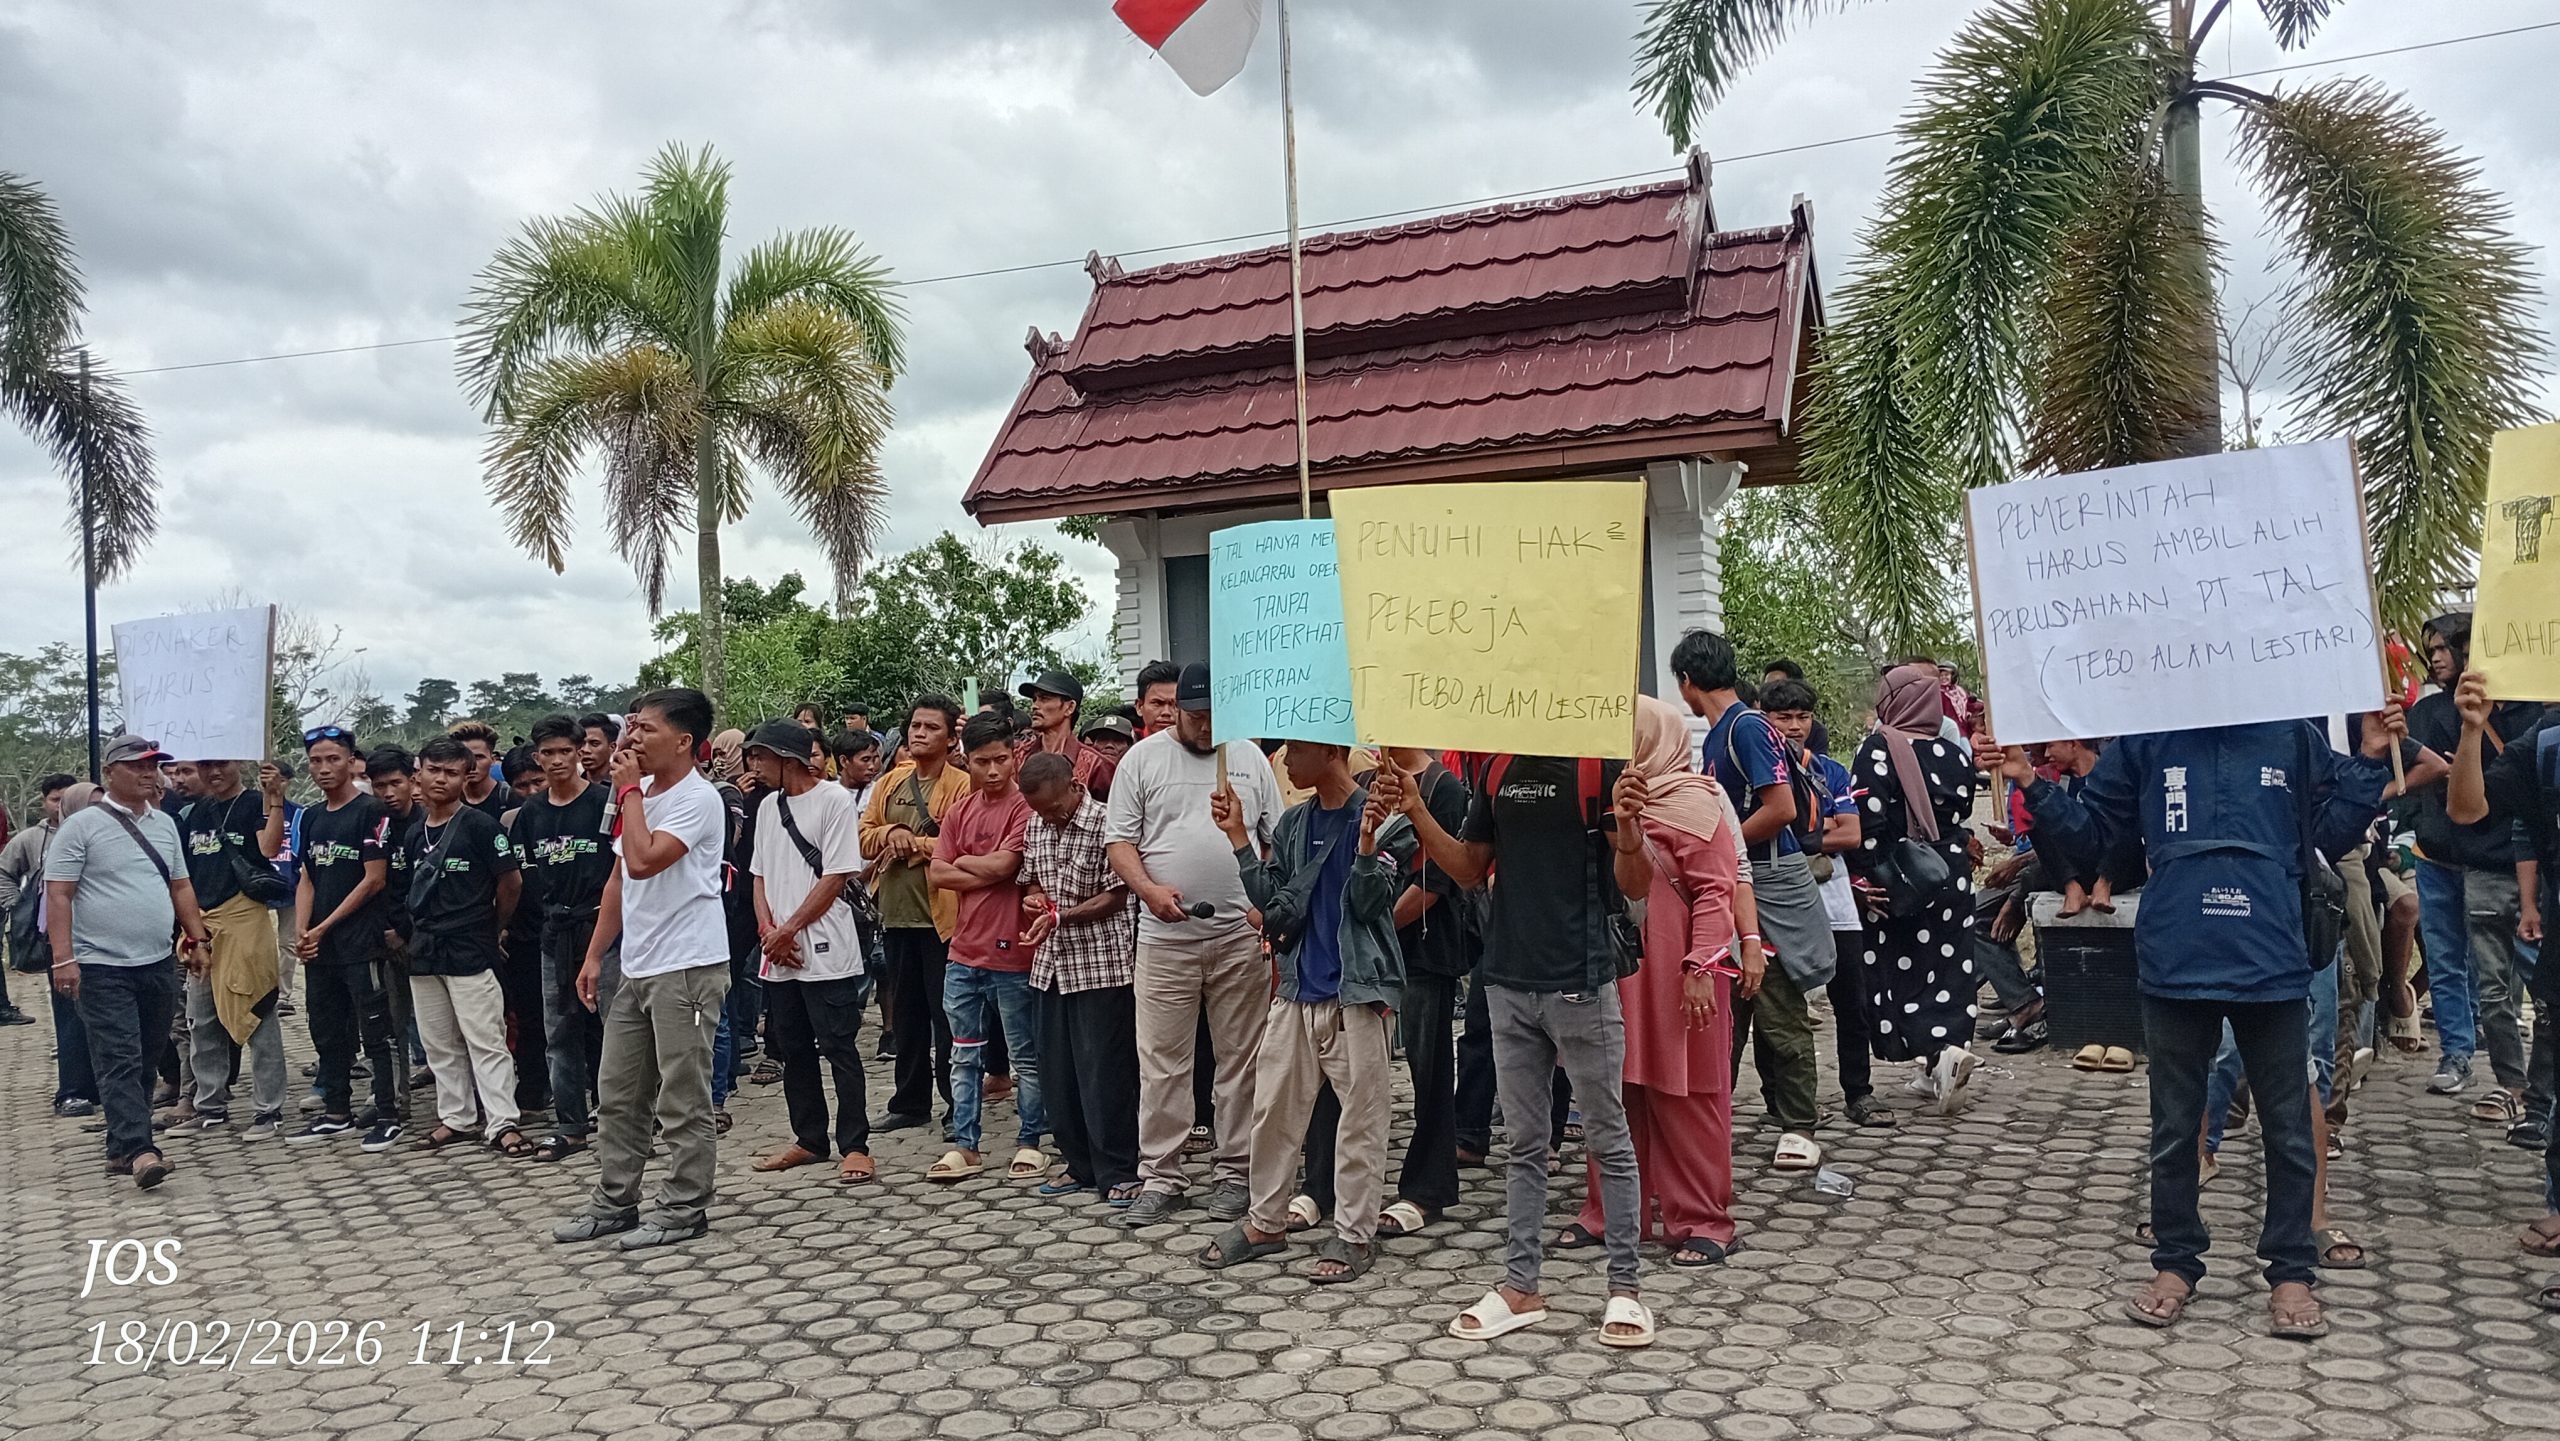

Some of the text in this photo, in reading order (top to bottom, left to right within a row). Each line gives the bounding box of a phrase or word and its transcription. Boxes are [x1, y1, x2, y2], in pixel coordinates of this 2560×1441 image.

[1226, 542, 1243, 562] TAL
[1255, 533, 1300, 553] HANYA
[1358, 509, 1482, 561] PENUHI
[2026, 541, 2127, 581] HARUS
[2153, 526, 2247, 563] AMBIL
[1252, 592, 1309, 621] TANPA
[1988, 564, 2343, 647] PERUSAHAAN PT TAL
[2151, 643, 2234, 672] ALAM
[133, 667, 216, 715] HARUS
[1264, 695, 1354, 732] PEKERJ
[1402, 672, 1464, 710] TEBO
[1469, 683, 1538, 718] ALAM
